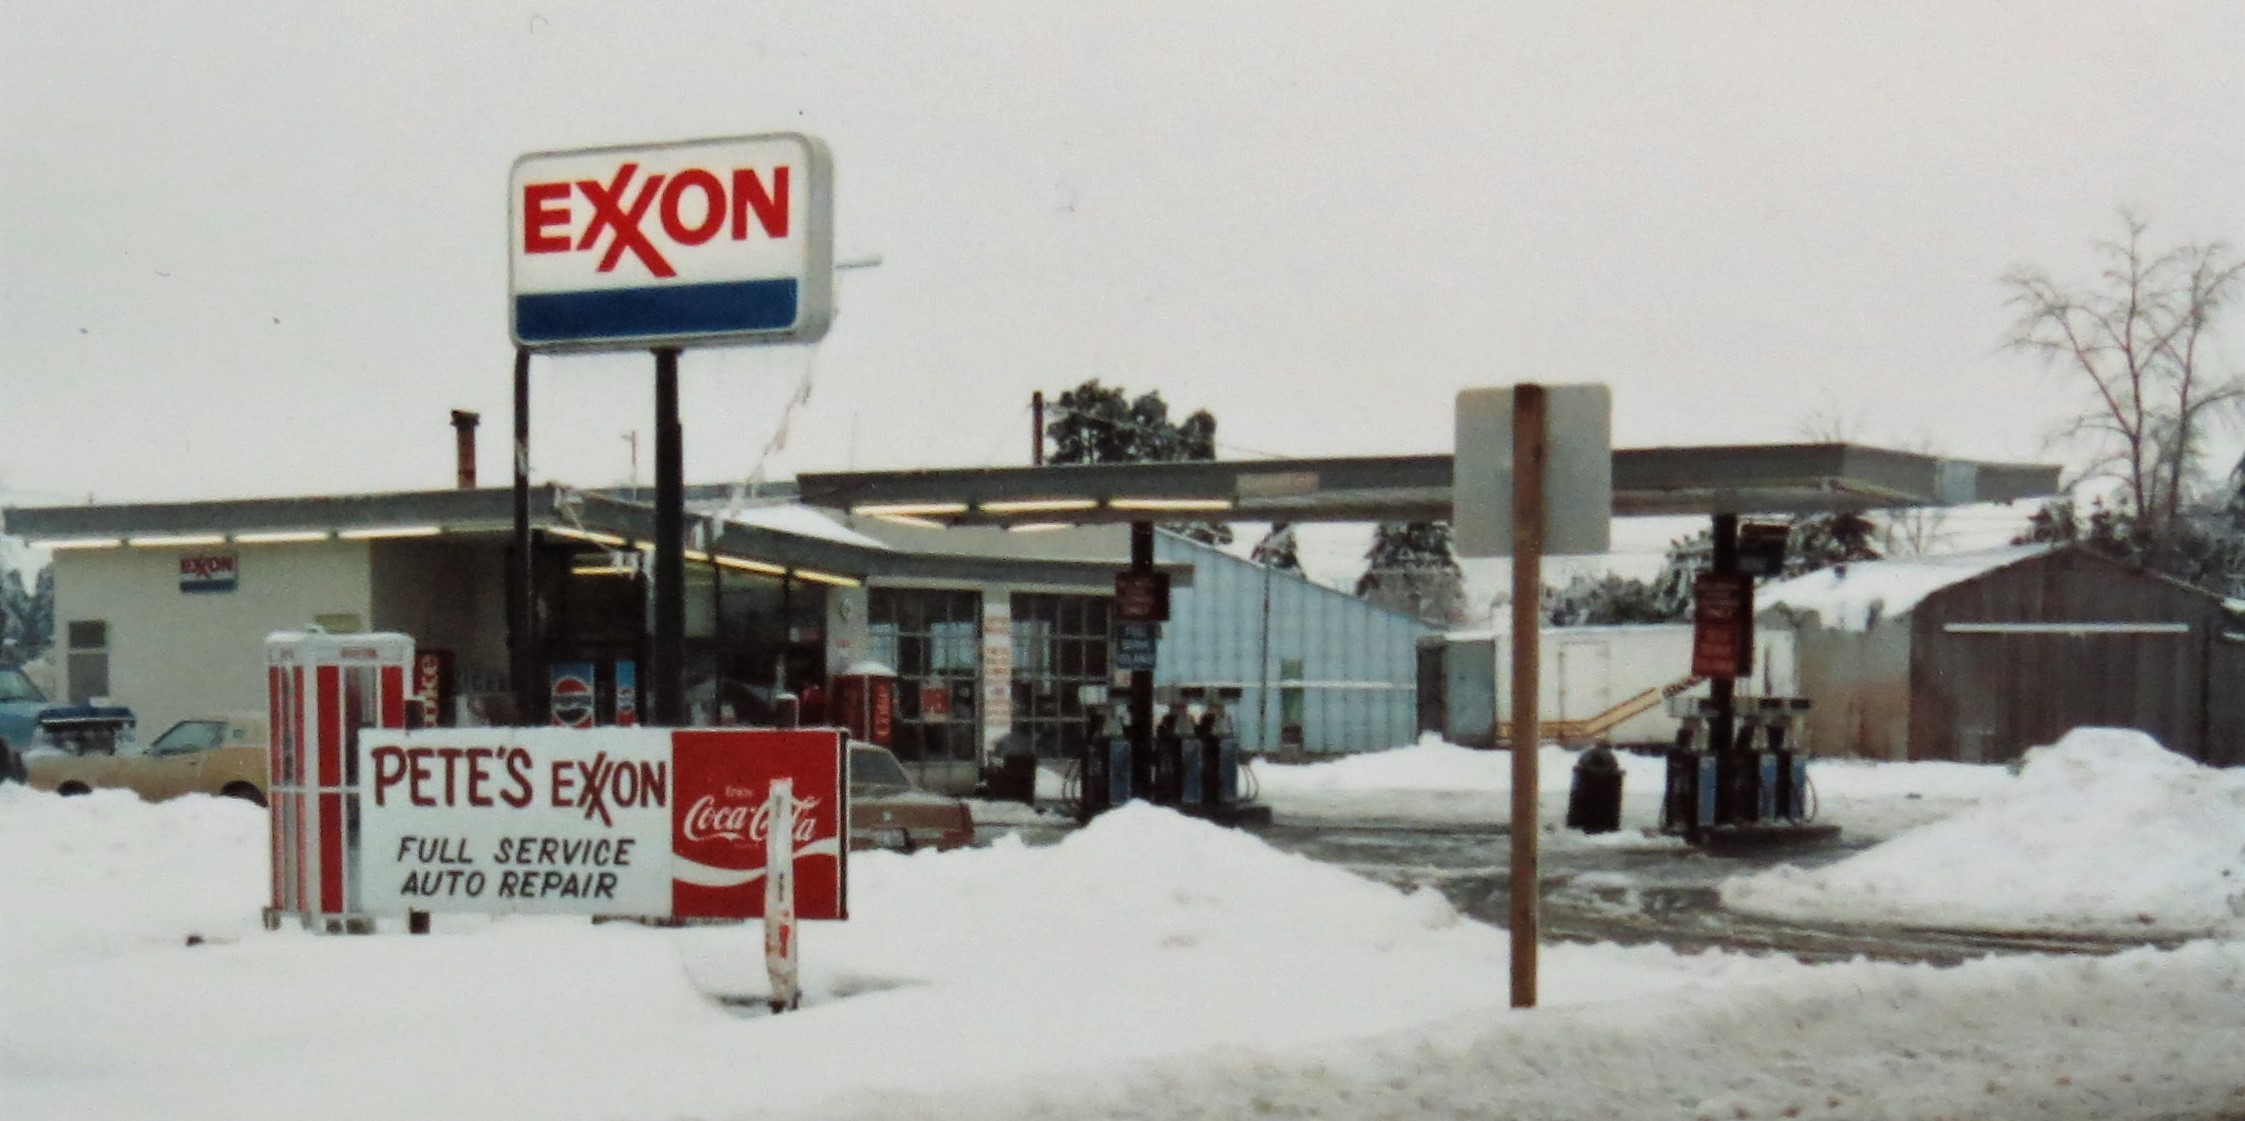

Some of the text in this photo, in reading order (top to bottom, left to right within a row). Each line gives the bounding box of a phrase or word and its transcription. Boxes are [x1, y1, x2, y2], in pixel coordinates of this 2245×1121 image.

[524, 163, 790, 278] EXXON
[180, 555, 234, 578] EXXON
[421, 653, 439, 728] oke
[371, 745, 667, 828] PETE'S EXXON
[684, 795, 821, 842] Coca-Ca
[397, 836, 636, 866] FULL SERVICE
[401, 871, 618, 900] AUTO REPAIR
